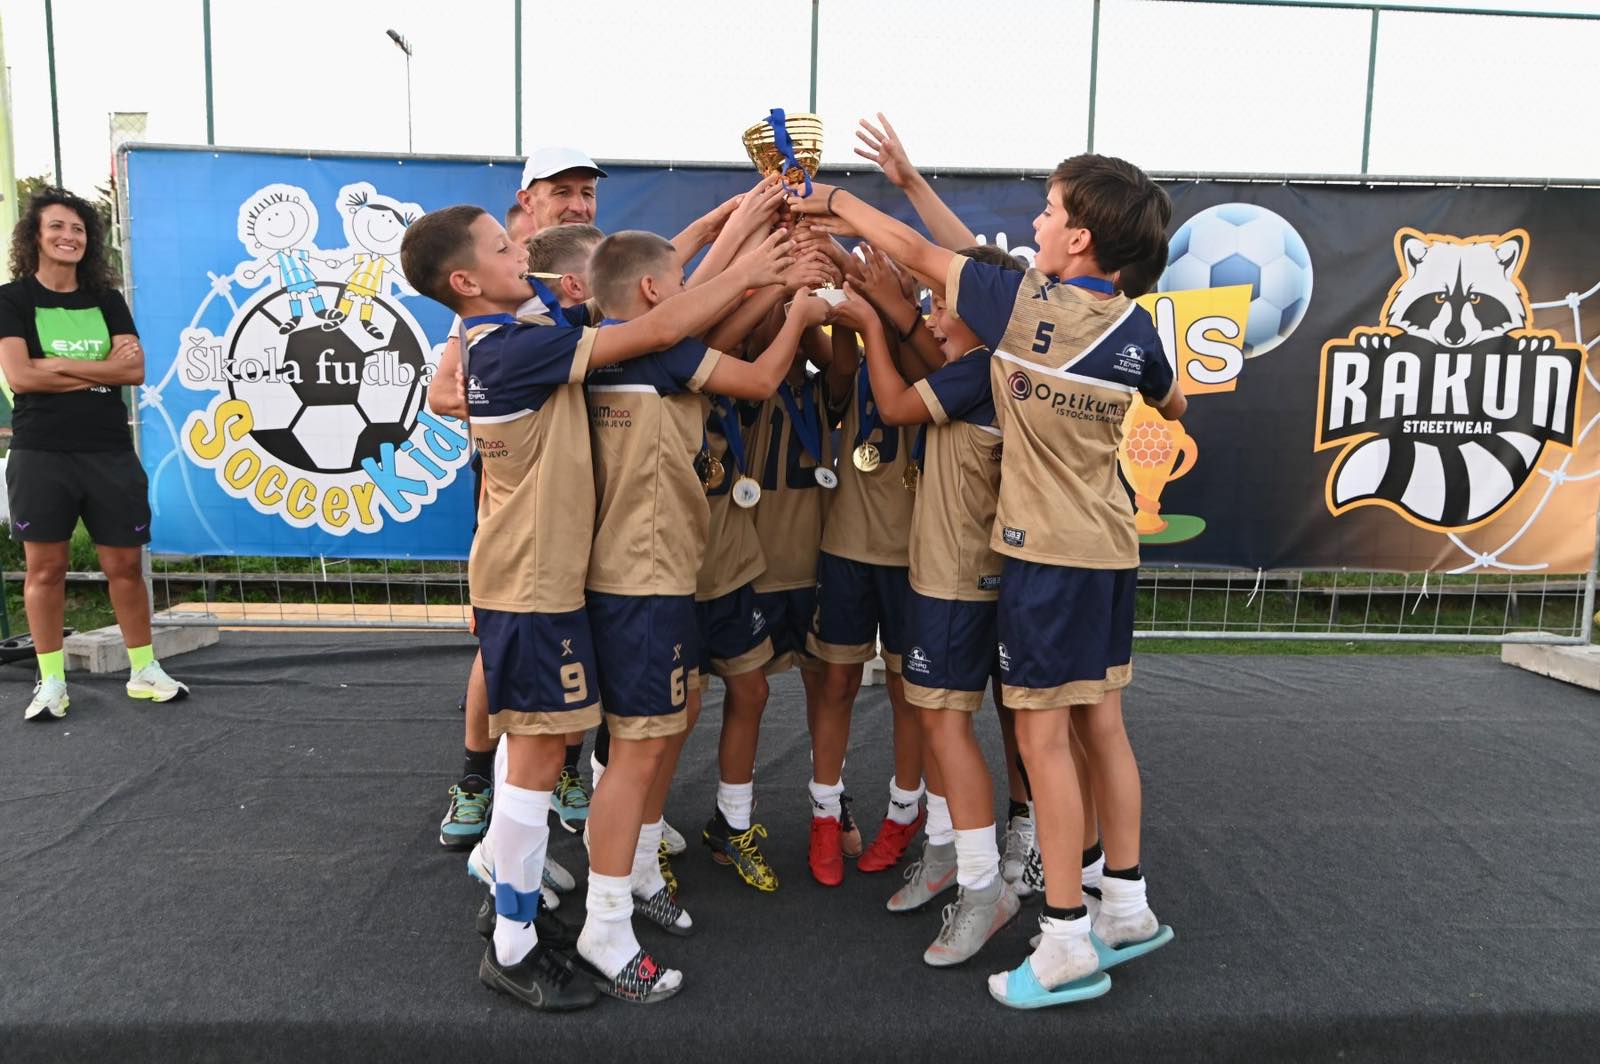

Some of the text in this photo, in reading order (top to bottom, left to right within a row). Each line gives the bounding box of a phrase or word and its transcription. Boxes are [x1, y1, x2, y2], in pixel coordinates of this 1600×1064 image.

[52, 340, 104, 351] EXIT
[1032, 320, 1055, 354] 5
[186, 337, 439, 387] Škola fudba
[1035, 383, 1118, 416] Optikum
[1328, 351, 1573, 435] RAKUN
[1402, 420, 1493, 434] STREETWEAR
[560, 661, 588, 704] 9
[670, 666, 686, 707] 6
